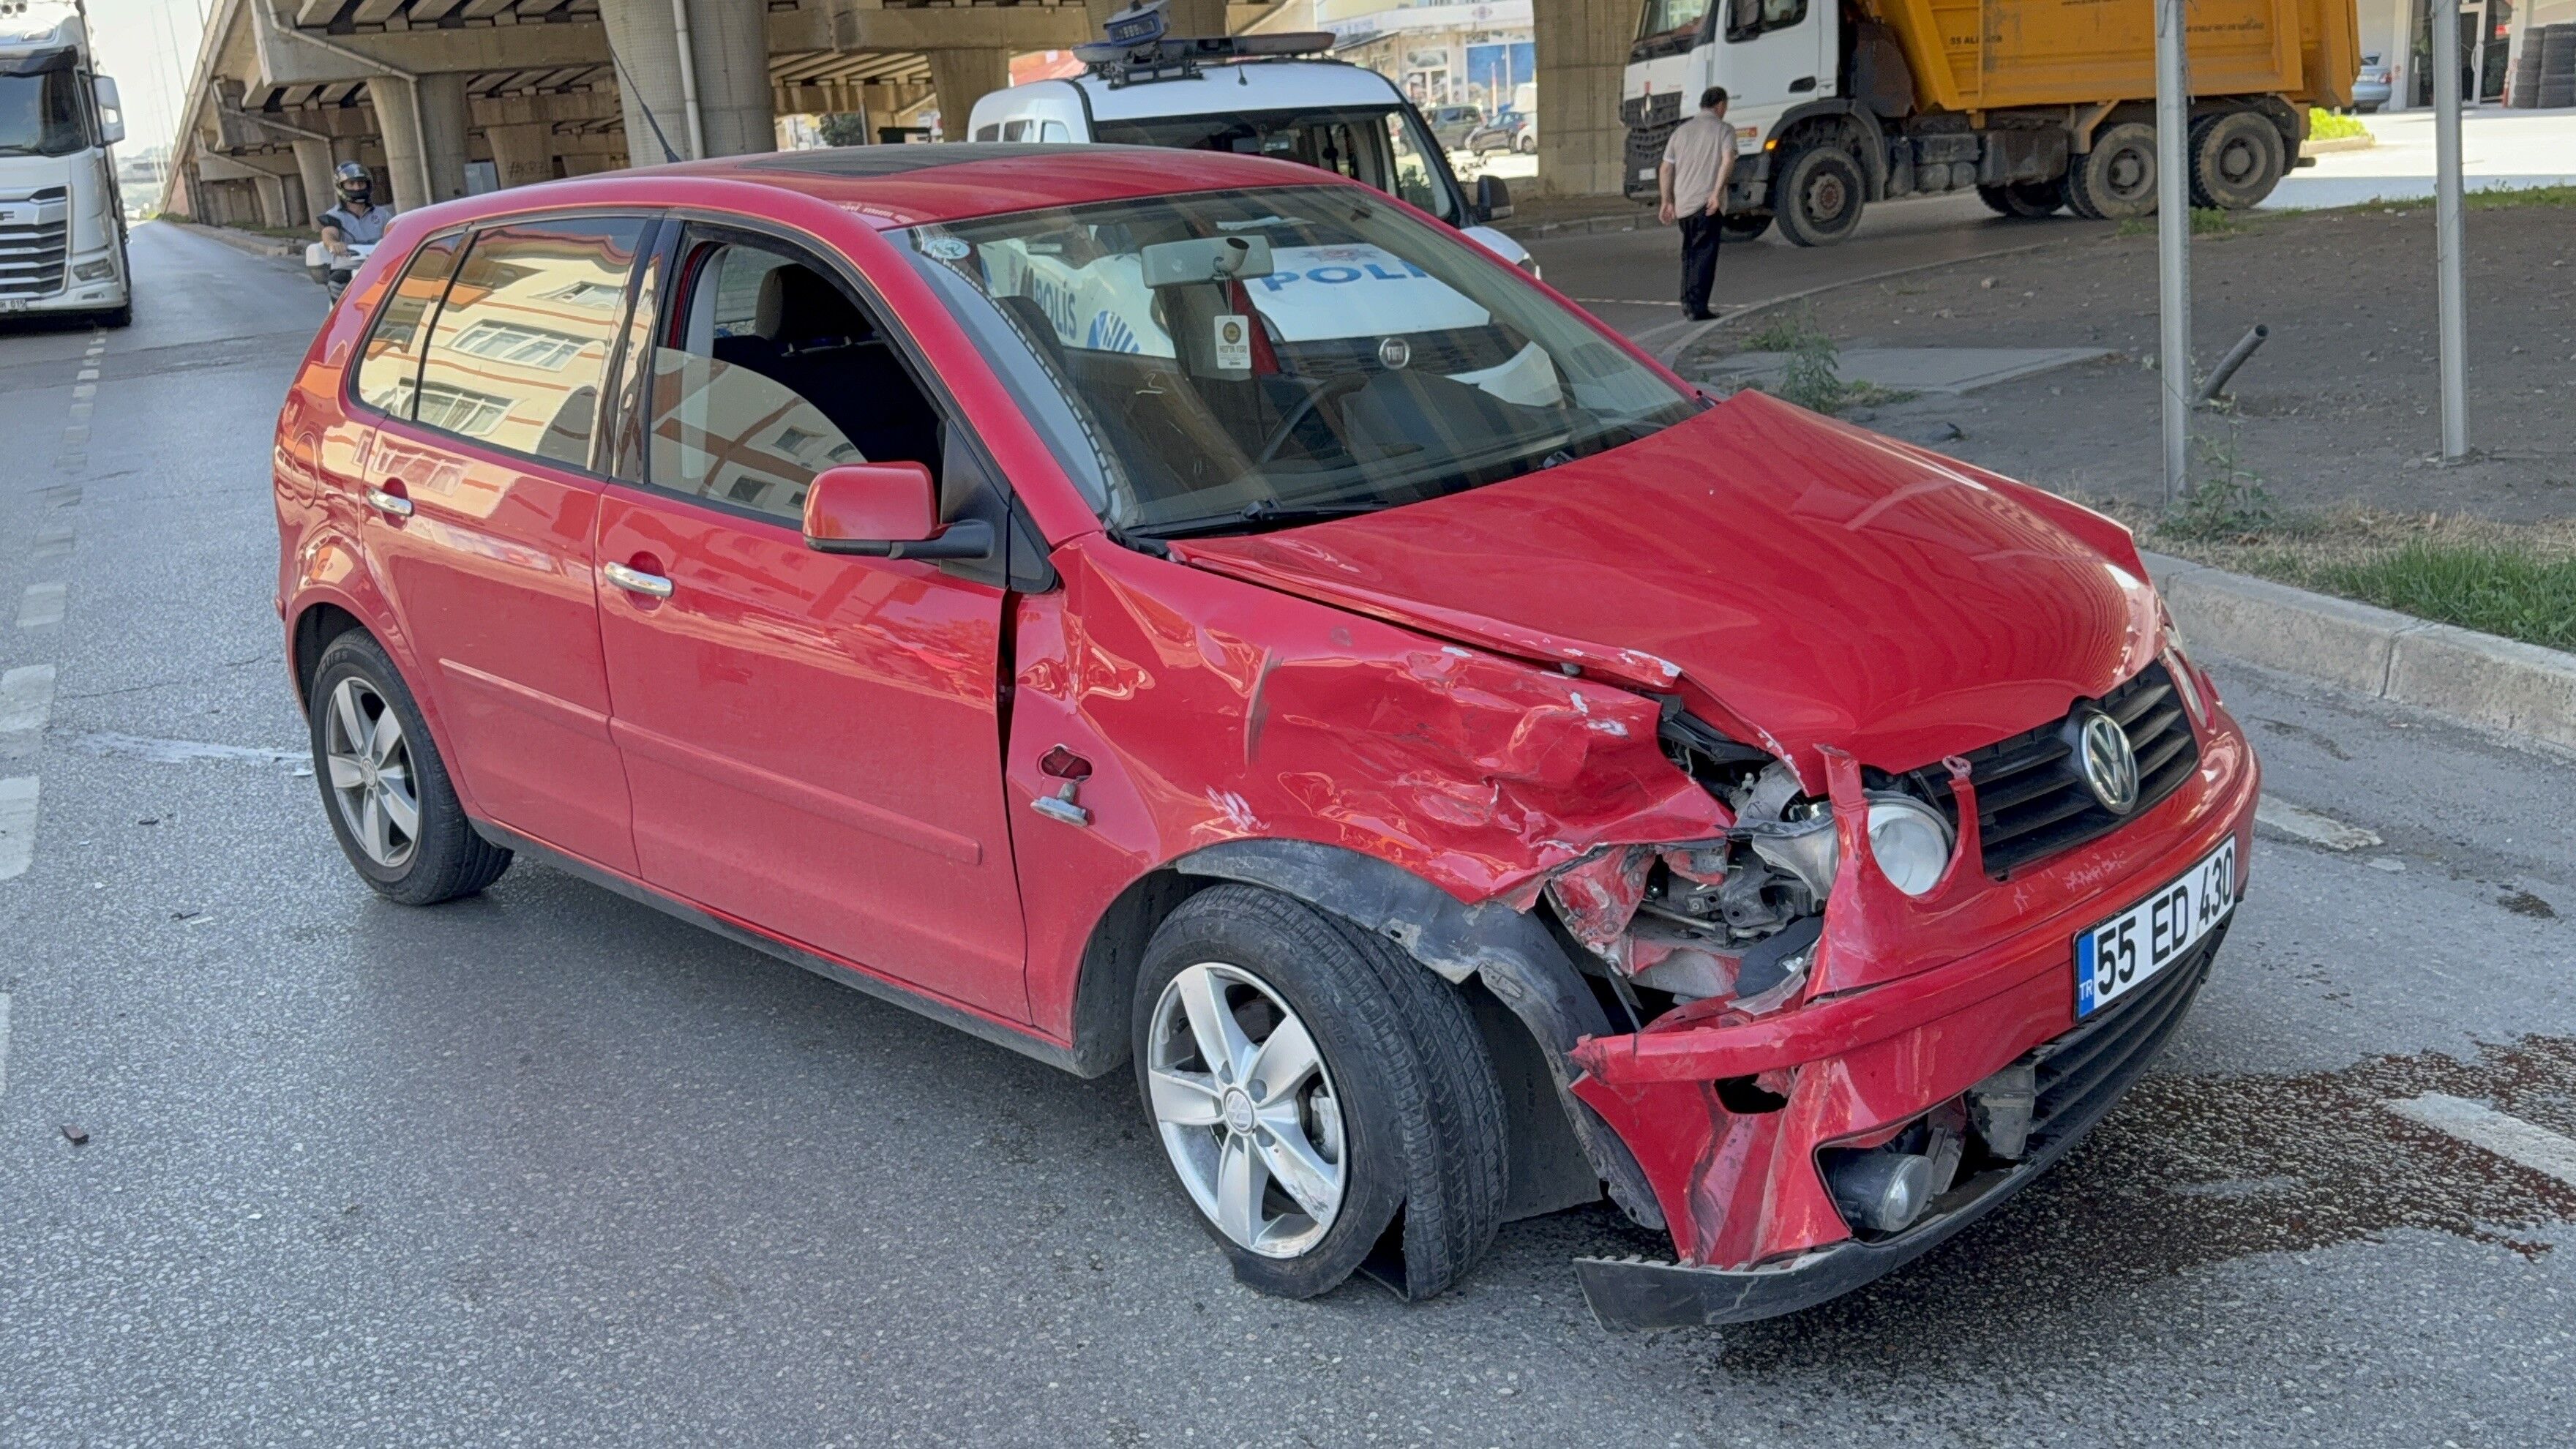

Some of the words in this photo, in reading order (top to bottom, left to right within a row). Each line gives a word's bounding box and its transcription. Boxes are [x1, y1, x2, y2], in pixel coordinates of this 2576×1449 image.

[1262, 259, 1426, 291] POLİ
[1035, 277, 1077, 340] POLİS
[2097, 916, 2135, 995] 55
[2152, 885, 2189, 966] ED
[2199, 846, 2233, 926] 430
[2079, 978, 2094, 1001] TR
